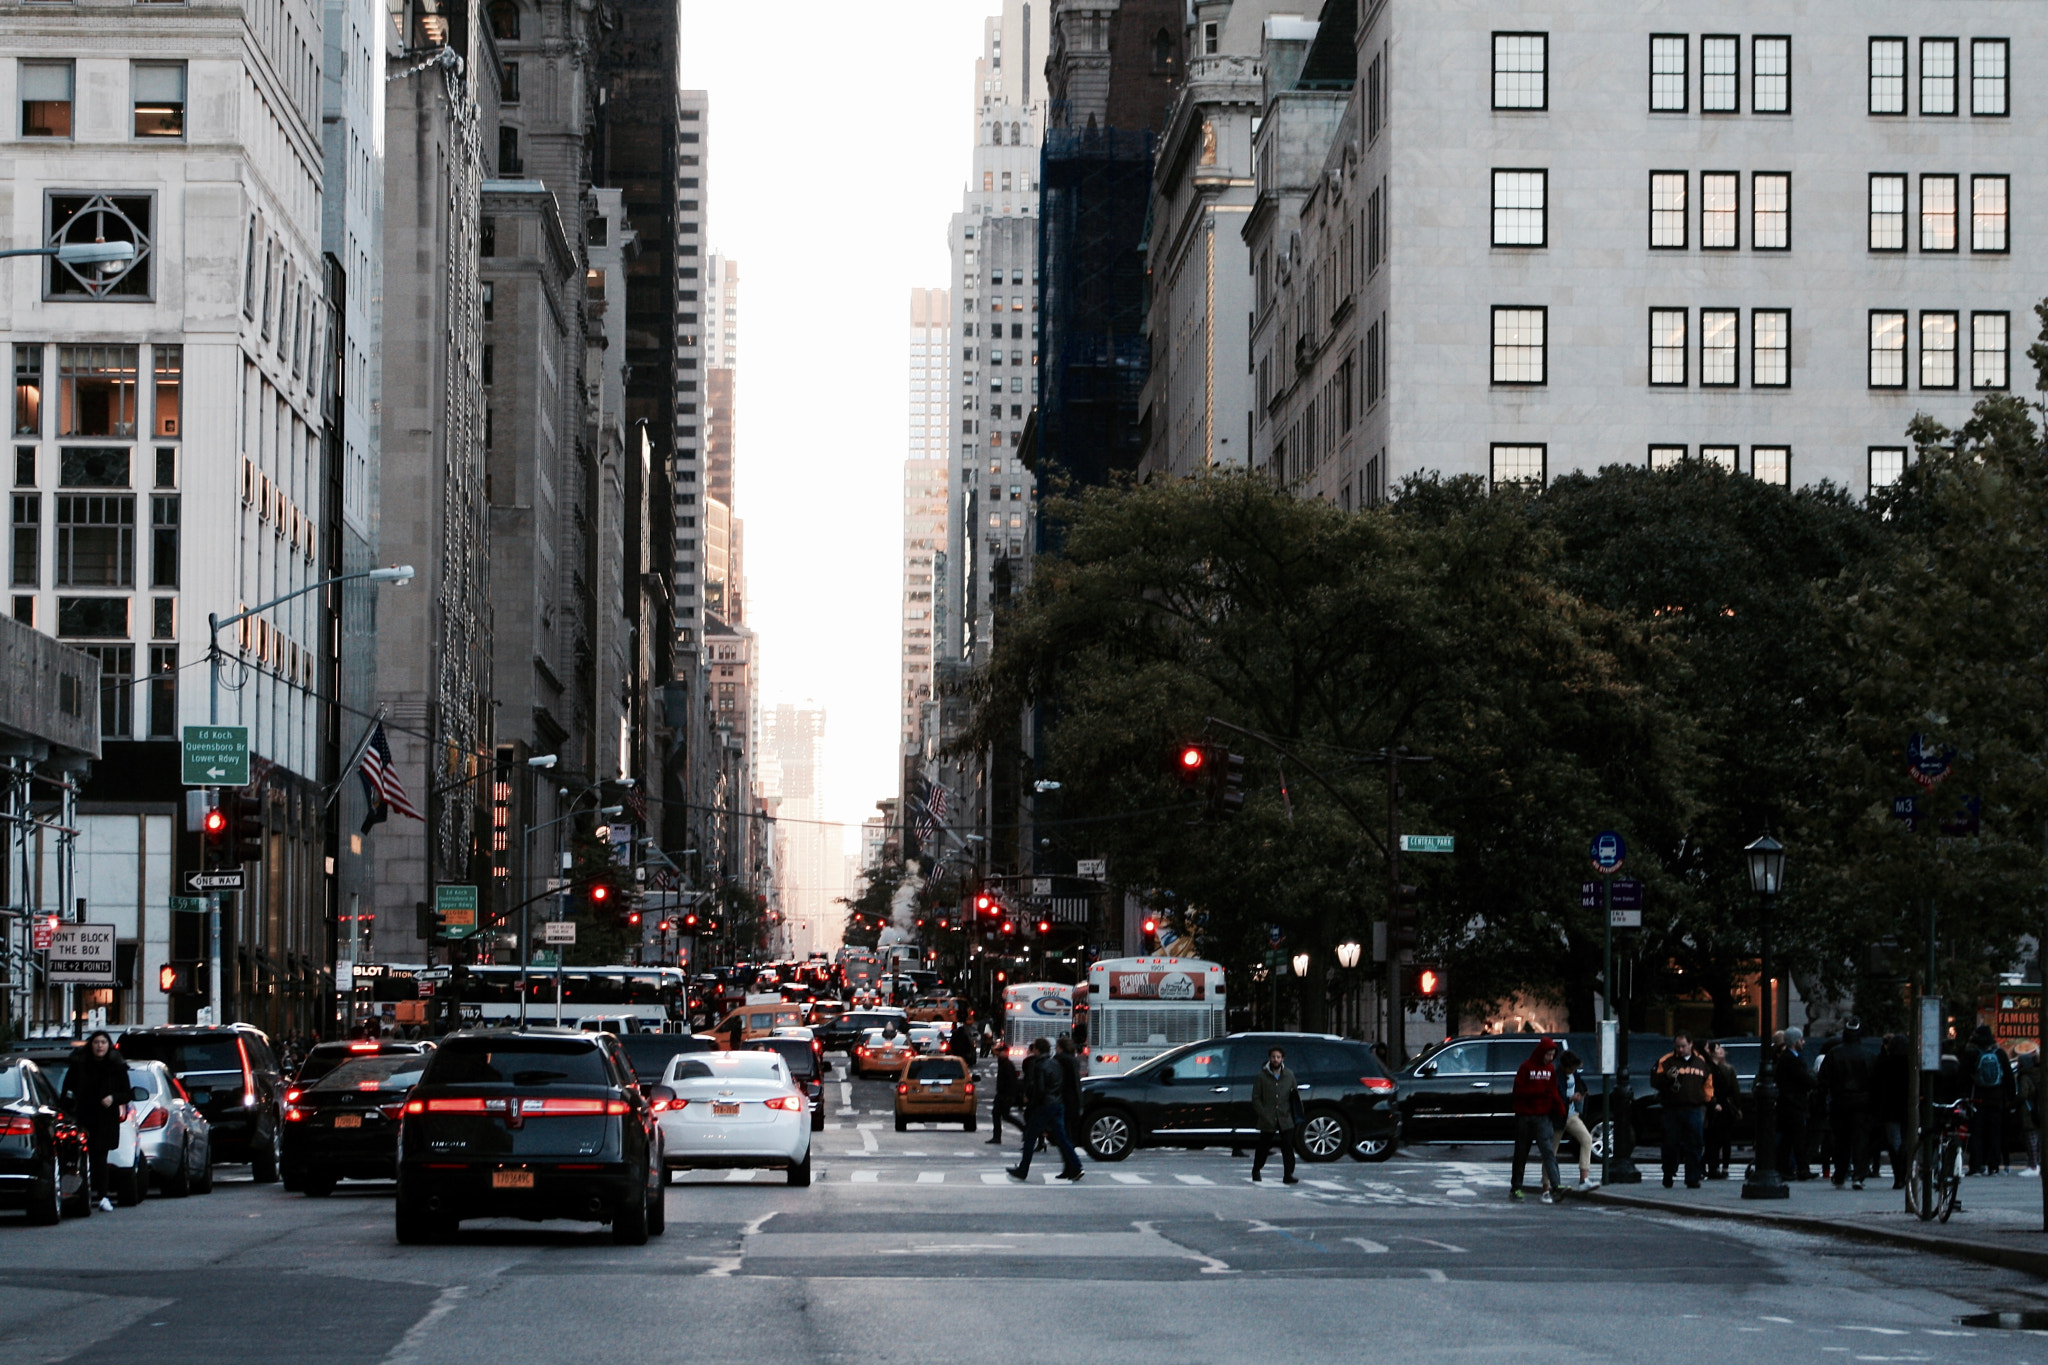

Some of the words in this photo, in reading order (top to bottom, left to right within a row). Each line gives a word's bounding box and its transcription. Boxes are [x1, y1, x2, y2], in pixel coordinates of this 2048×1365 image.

[199, 731, 209, 739] Ed
[212, 731, 233, 739] Koch
[186, 743, 233, 751] Queensboro
[236, 743, 246, 751] Br
[192, 754, 215, 762] Lower
[218, 754, 240, 765] Rdwy
[1896, 799, 1912, 812] M3
[196, 877, 214, 885] ONE
[1582, 883, 1594, 893] M1
[1582, 896, 1595, 906] M4
[80, 933, 109, 942] BLOCK
[59, 945, 77, 954] THE
[82, 945, 100, 954] BOX
[82, 962, 109, 971] POINTS
[1119, 973, 1150, 987] SPOOKY
[1999, 1013, 2039, 1024] FAMOUS
[2000, 1025, 2039, 1036] GRILLED
